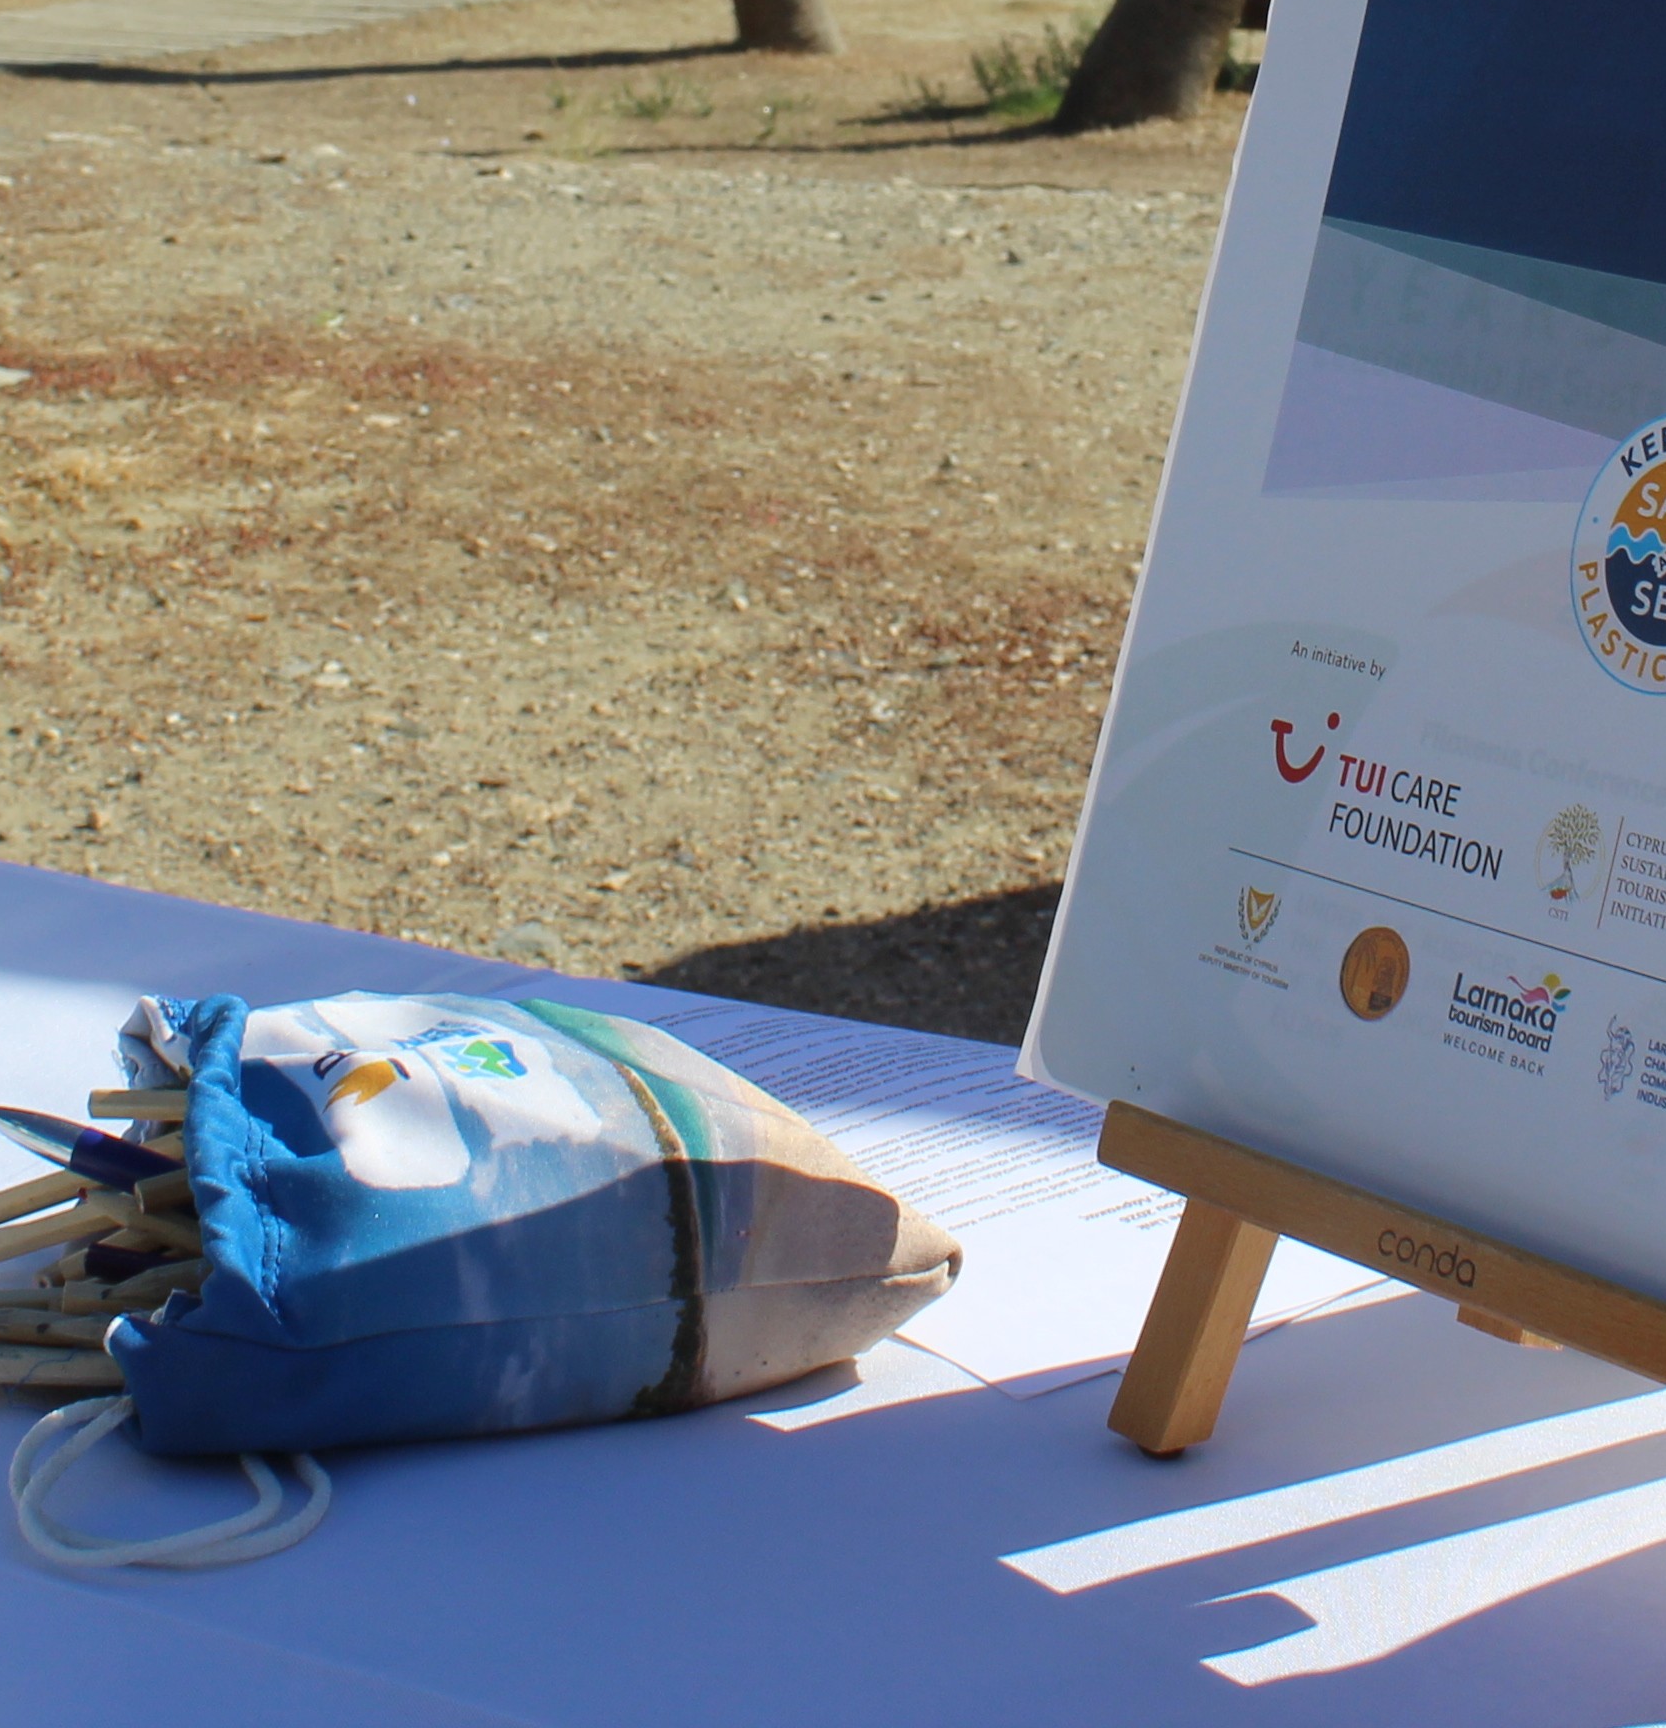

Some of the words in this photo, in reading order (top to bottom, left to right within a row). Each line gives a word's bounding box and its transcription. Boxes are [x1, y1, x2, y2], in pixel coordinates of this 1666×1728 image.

[1291, 640, 1308, 659] An
[1311, 644, 1366, 673] initiative
[1370, 659, 1386, 681] by
[1339, 754, 1387, 797] TUI
[1391, 770, 1461, 817] CARE
[1329, 802, 1503, 881] FOUNDATION
[1548, 907, 1570, 922] CSTI
[1448, 1004, 1505, 1038] tourism
[1507, 1022, 1552, 1053] board
[1452, 972, 1558, 1033] Larnaka
[1443, 1032, 1505, 1064] WELCOME
[1510, 1055, 1545, 1077] BACK
[1378, 1229, 1476, 1287] conda
